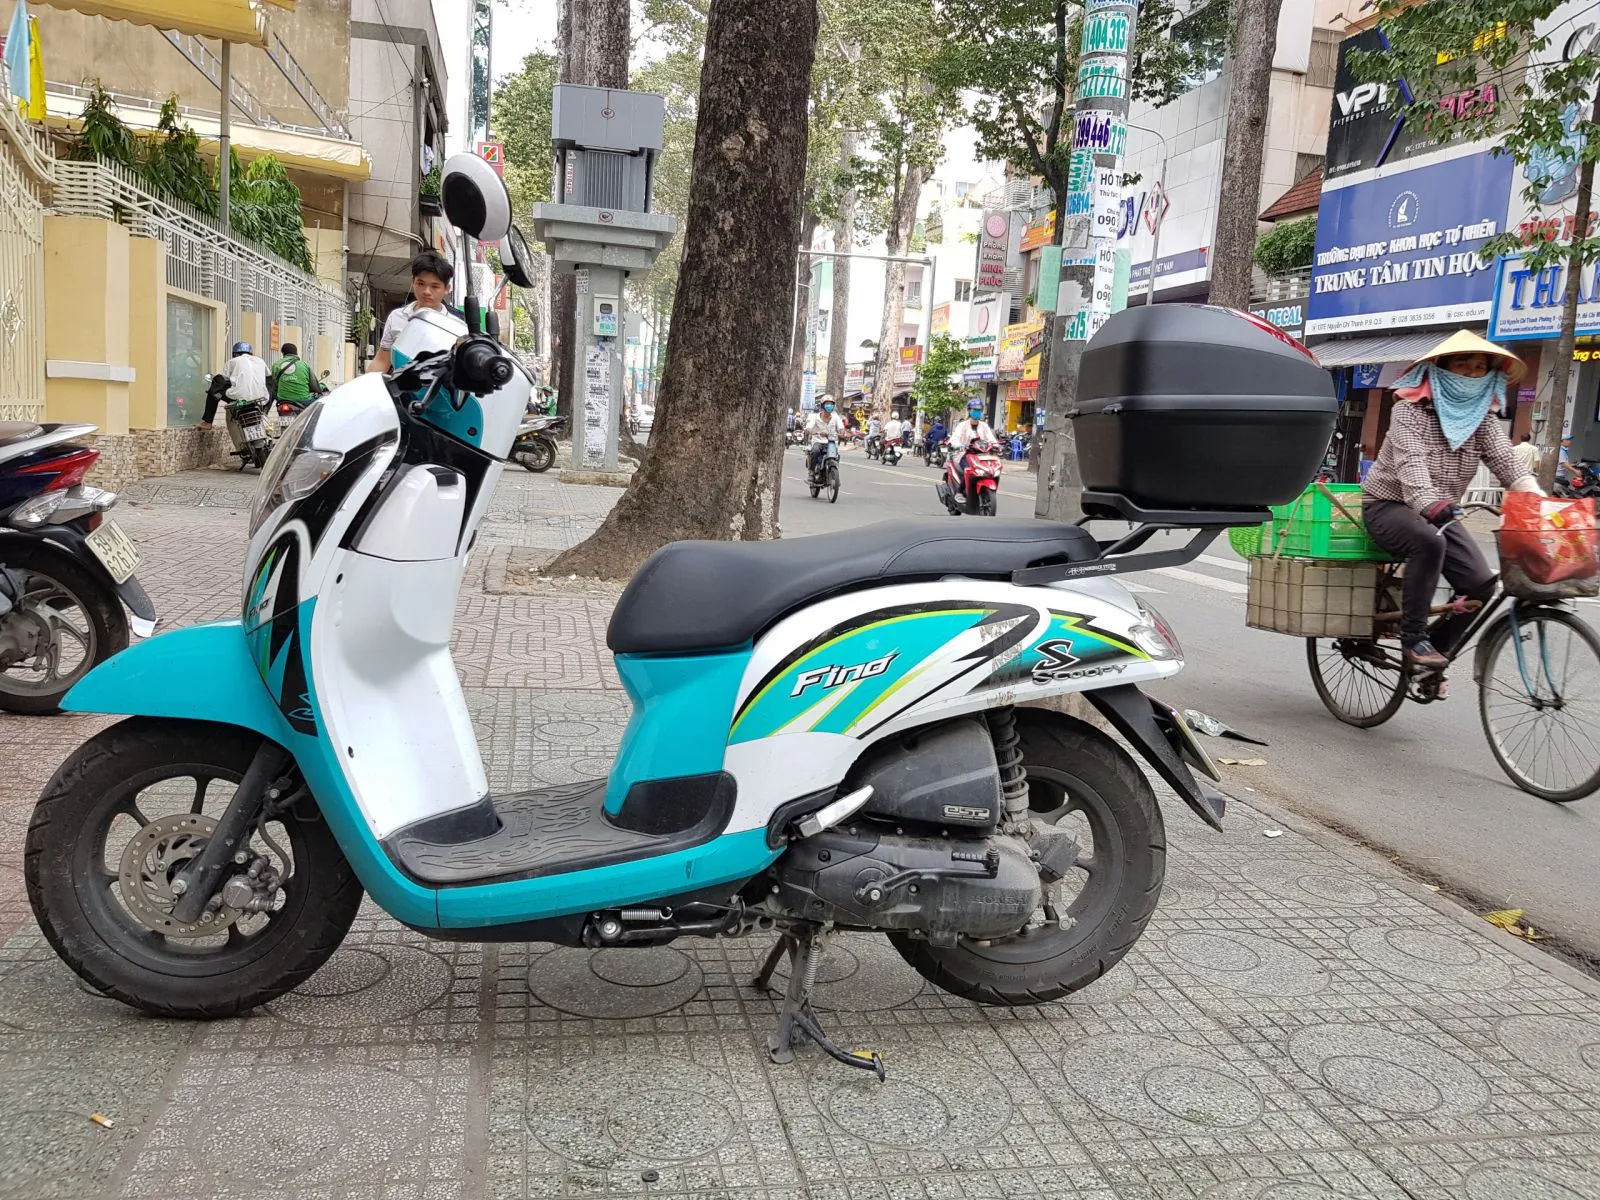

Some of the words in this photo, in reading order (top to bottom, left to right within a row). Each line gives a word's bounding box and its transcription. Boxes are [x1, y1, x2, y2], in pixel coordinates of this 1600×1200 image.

[1333, 111, 1366, 128] FITNESS
[1317, 246, 1349, 267] TRƯỜNG
[1350, 245, 1366, 262] ĐẠI
[1366, 241, 1387, 259] HỌC
[1389, 236, 1417, 254] KHOA
[1419, 231, 1443, 251] HỌC
[1445, 224, 1462, 246] TỰ
[1462, 218, 1497, 241] NHIÊN
[981, 263, 1003, 274] MINH
[1315, 268, 1367, 295] TRUNG
[1370, 260, 1410, 287] TÂM
[1412, 255, 1446, 280] TIN
[1447, 250, 1493, 278] HỌC
[979, 276, 1003, 287] PHÚC
[1267, 305, 1303, 327] DECAL
[789, 648, 902, 698] Fino
